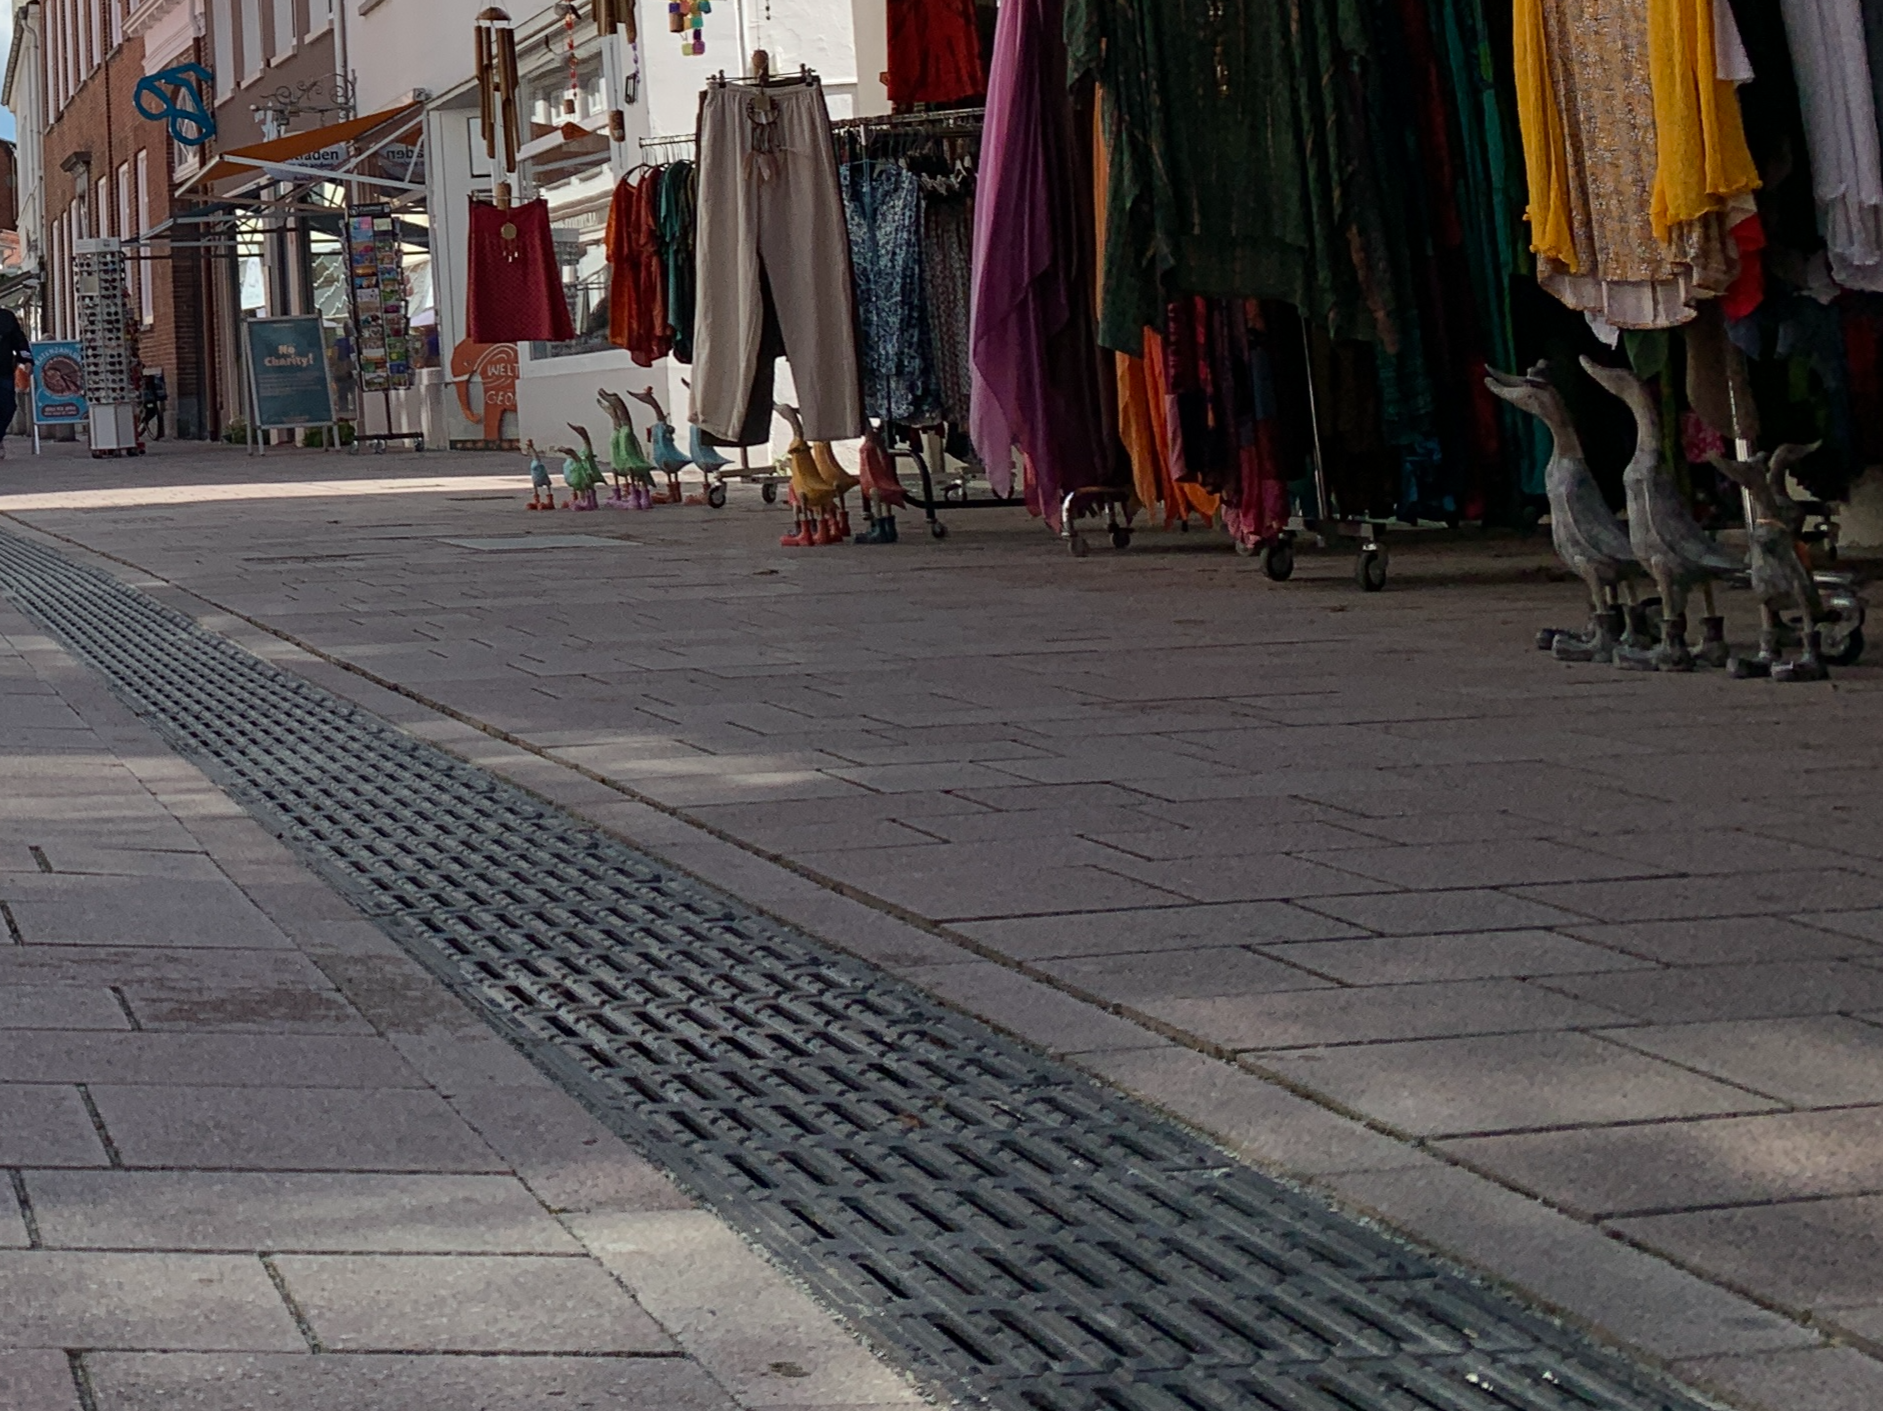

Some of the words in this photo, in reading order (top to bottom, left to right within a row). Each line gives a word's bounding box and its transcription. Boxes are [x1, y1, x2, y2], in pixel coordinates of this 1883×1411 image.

[278, 344, 296, 355] No
[263, 353, 314, 367] Charity!
[487, 362, 521, 376] WELT
